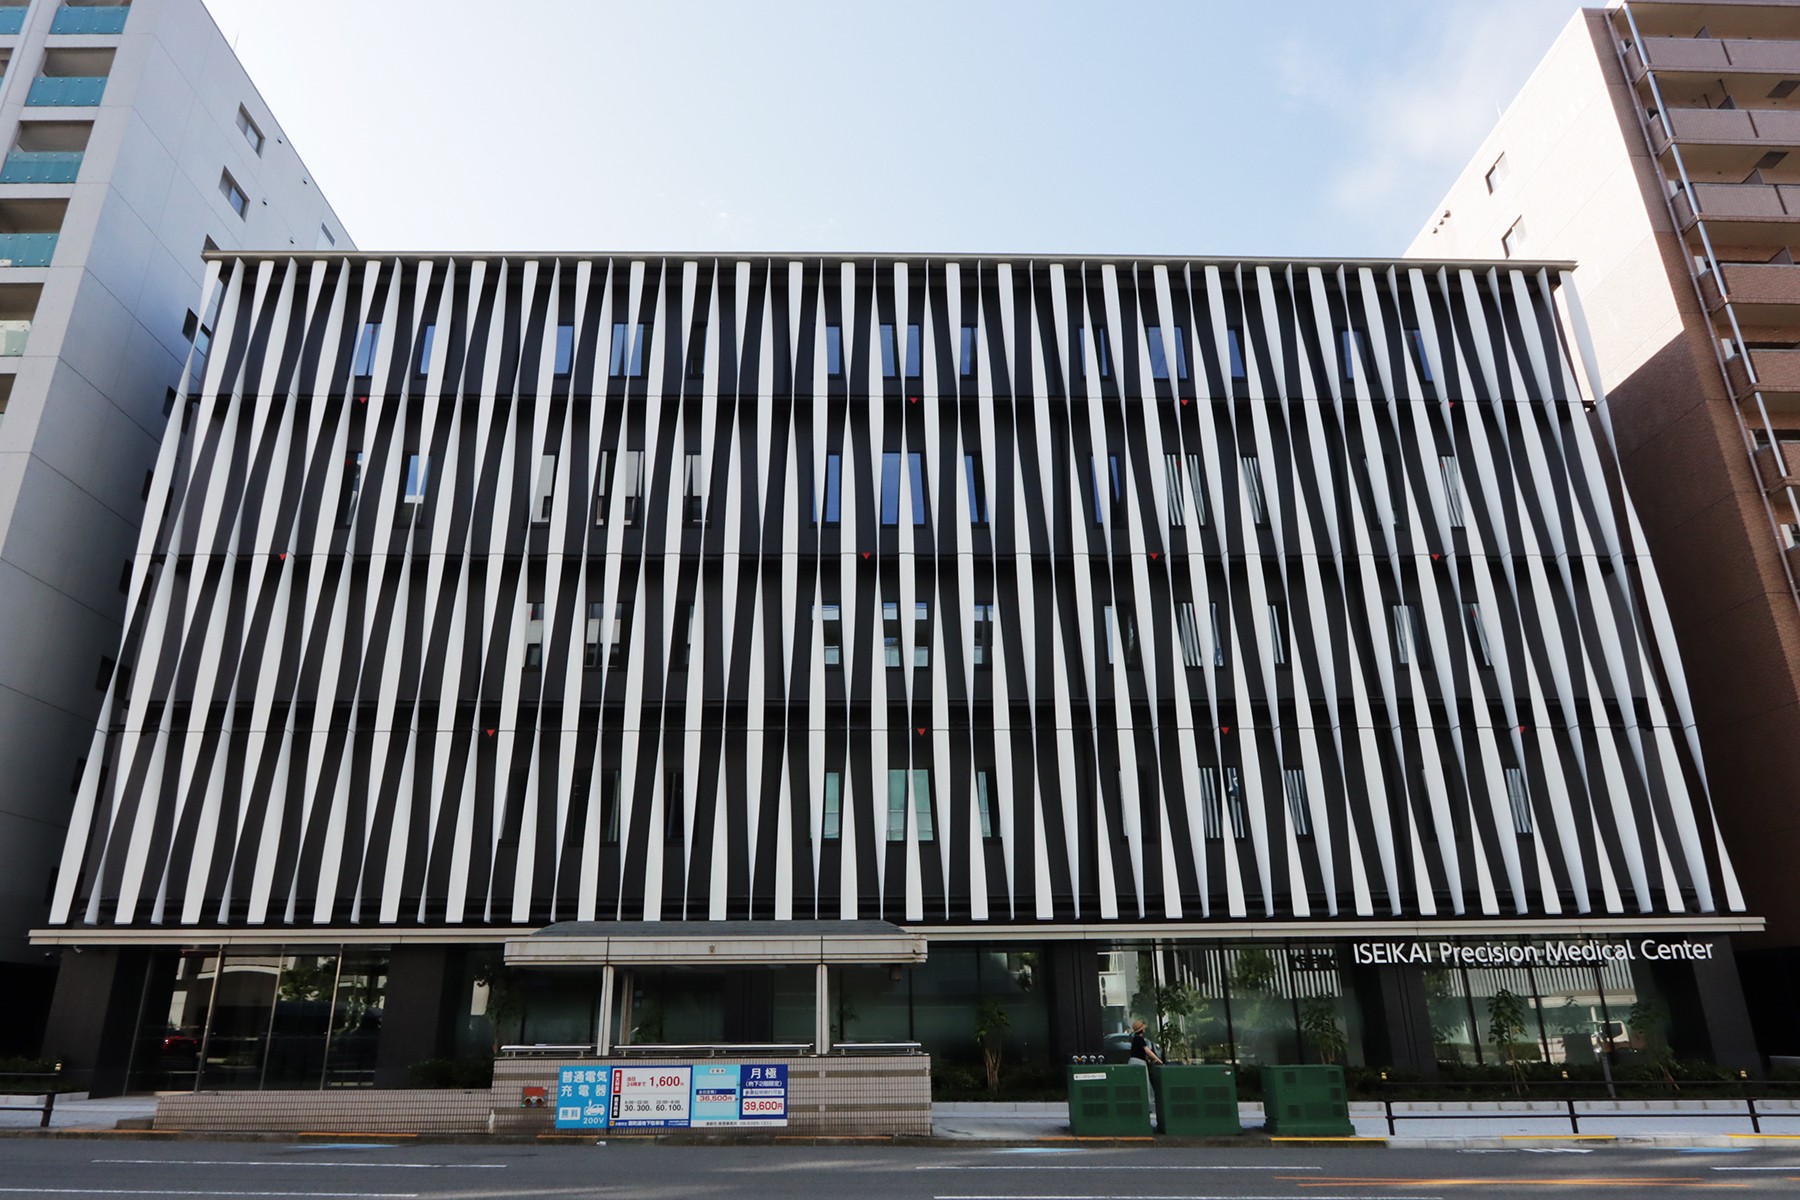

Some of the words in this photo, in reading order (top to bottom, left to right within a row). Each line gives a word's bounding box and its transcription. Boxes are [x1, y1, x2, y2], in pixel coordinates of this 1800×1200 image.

[1353, 943, 1432, 964] ISEIKAI
[1440, 941, 1539, 964] Precision
[1545, 939, 1636, 962] Medical
[1641, 939, 1714, 961] Center
[562, 1071, 608, 1083] 普通電気
[750, 1067, 777, 1079] 月極
[744, 1101, 783, 1111] 39,600円
[561, 1109, 579, 1118] 無料
[583, 1117, 605, 1125] 200V
